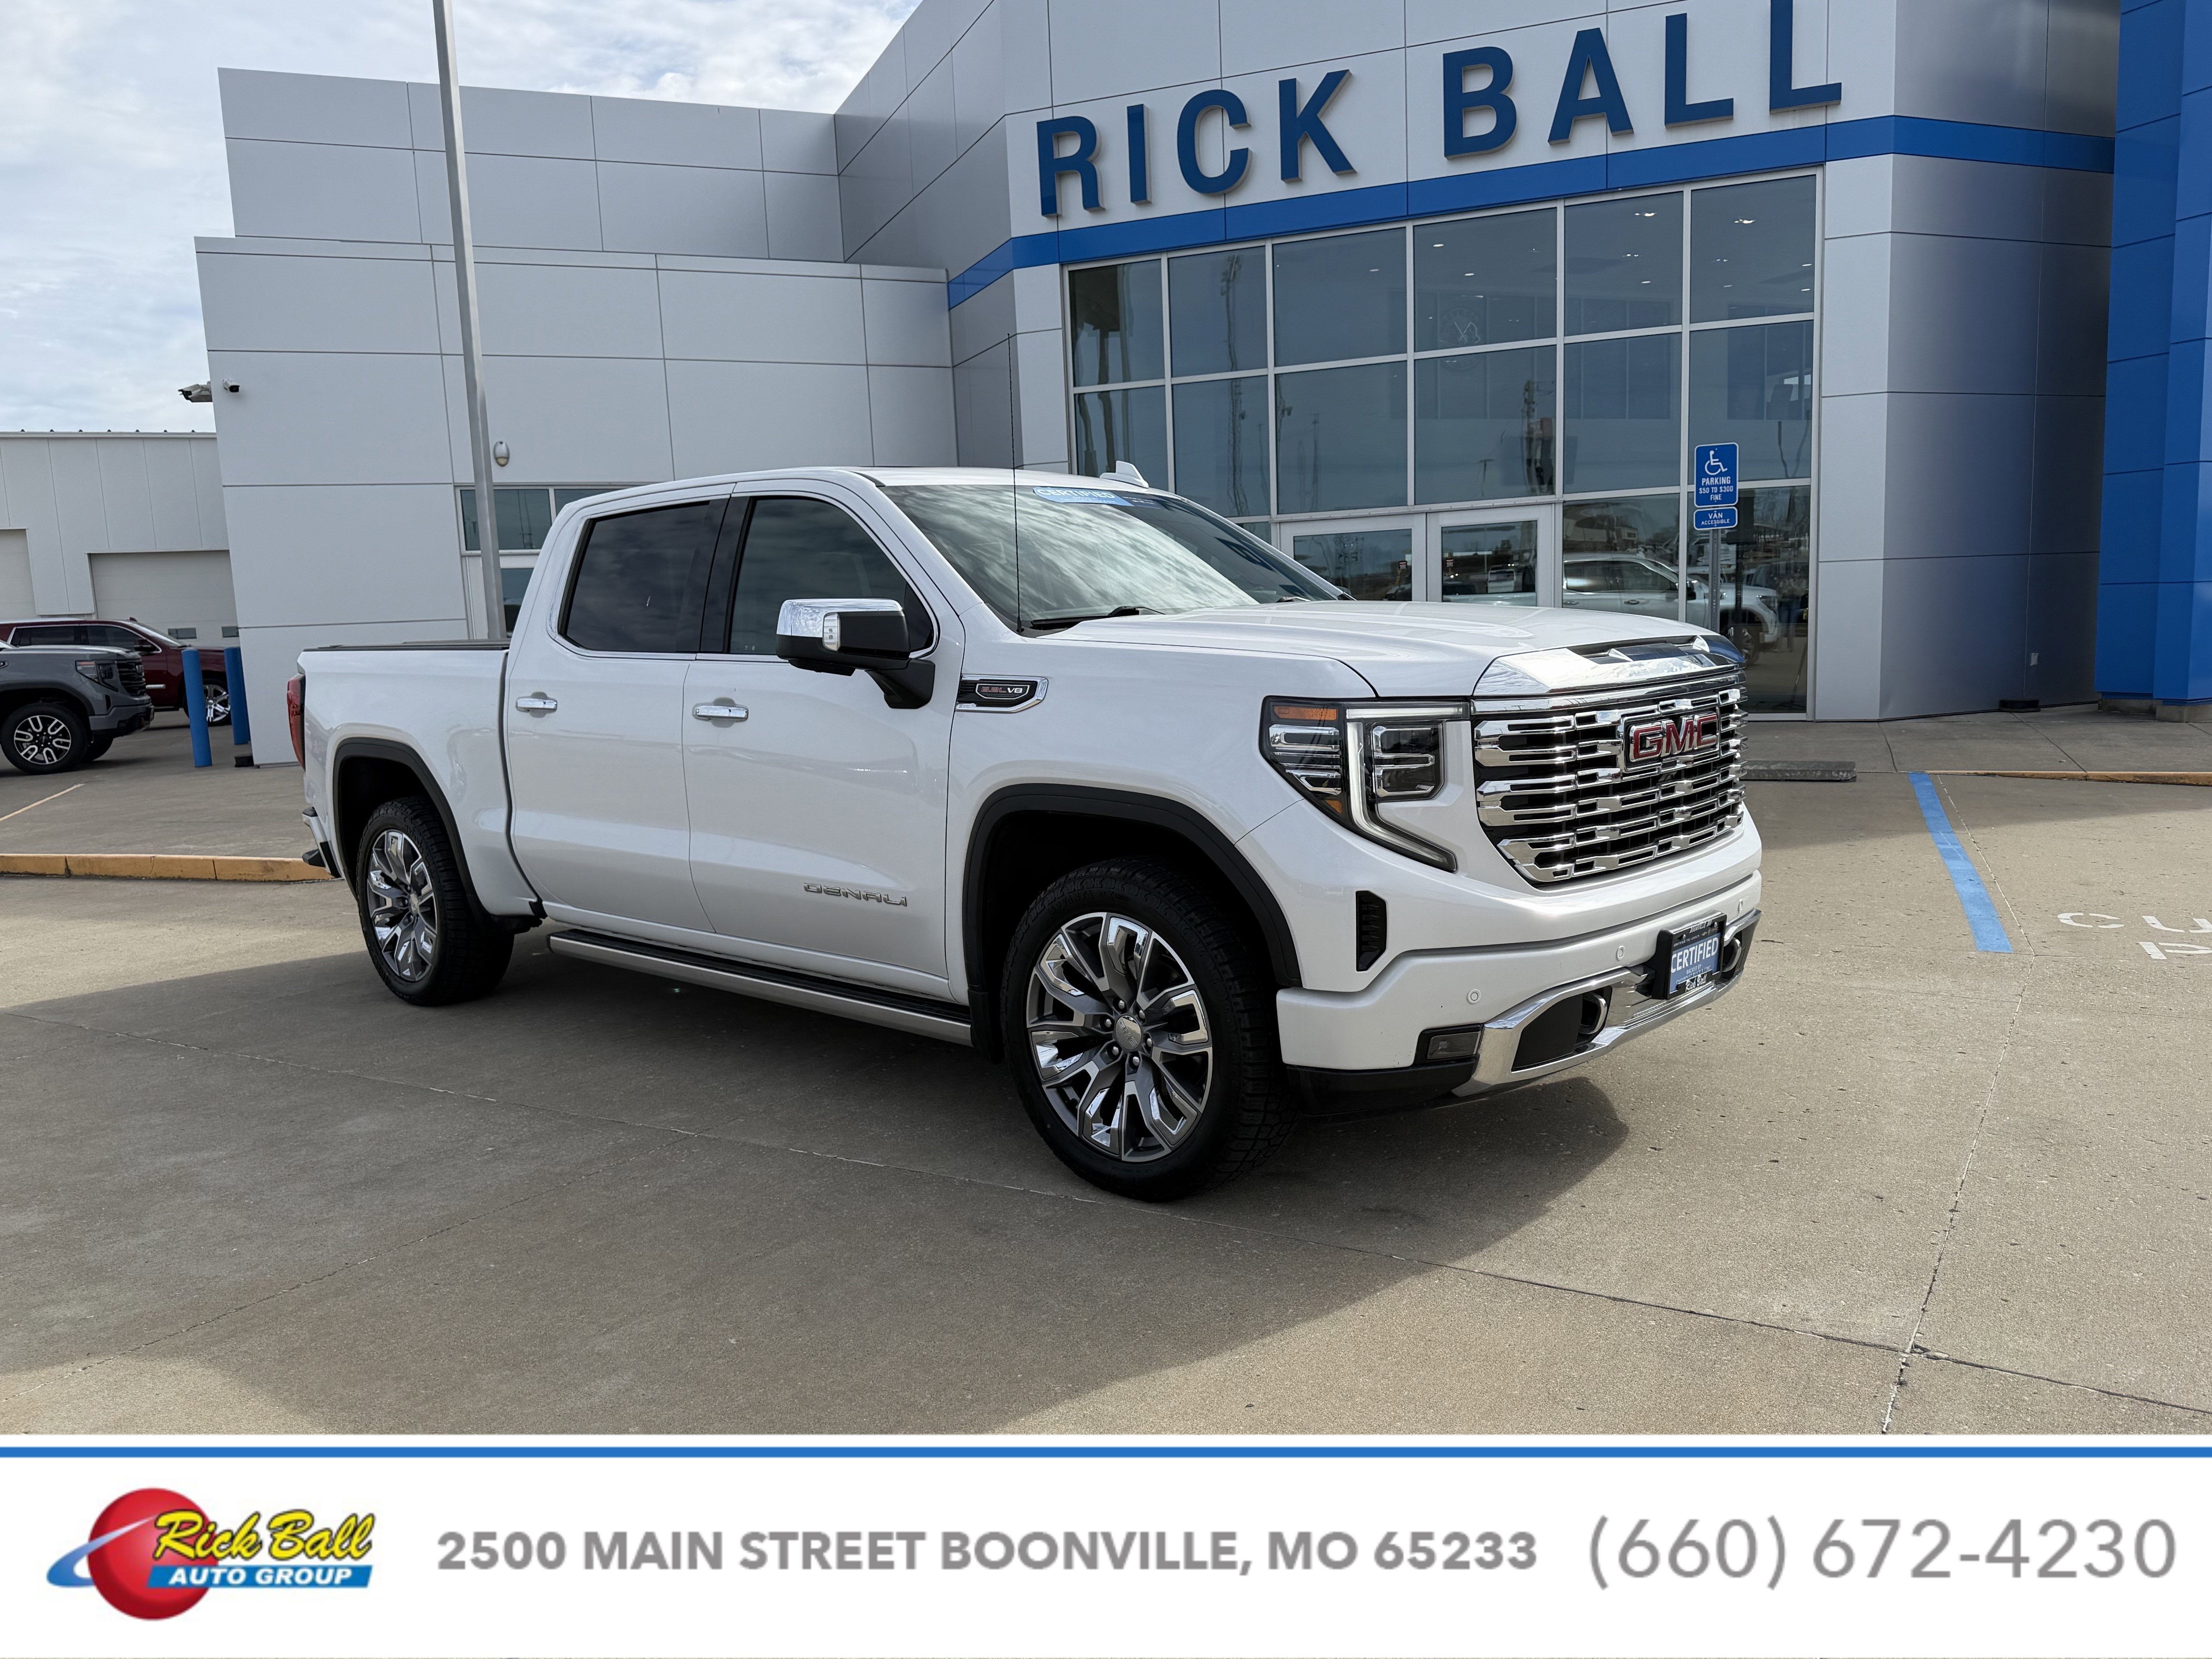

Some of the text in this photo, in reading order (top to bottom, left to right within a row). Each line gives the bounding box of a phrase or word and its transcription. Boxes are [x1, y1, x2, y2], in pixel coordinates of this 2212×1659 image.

[1037, 0, 1843, 218] RICK BALL
[1036, 489, 1115, 499] CERTIFIED
[1702, 476, 1731, 486] PARKING
[1629, 712, 1717, 763] GMC
[803, 881, 907, 907] DENALI
[1671, 937, 1719, 973] CERTIFIED
